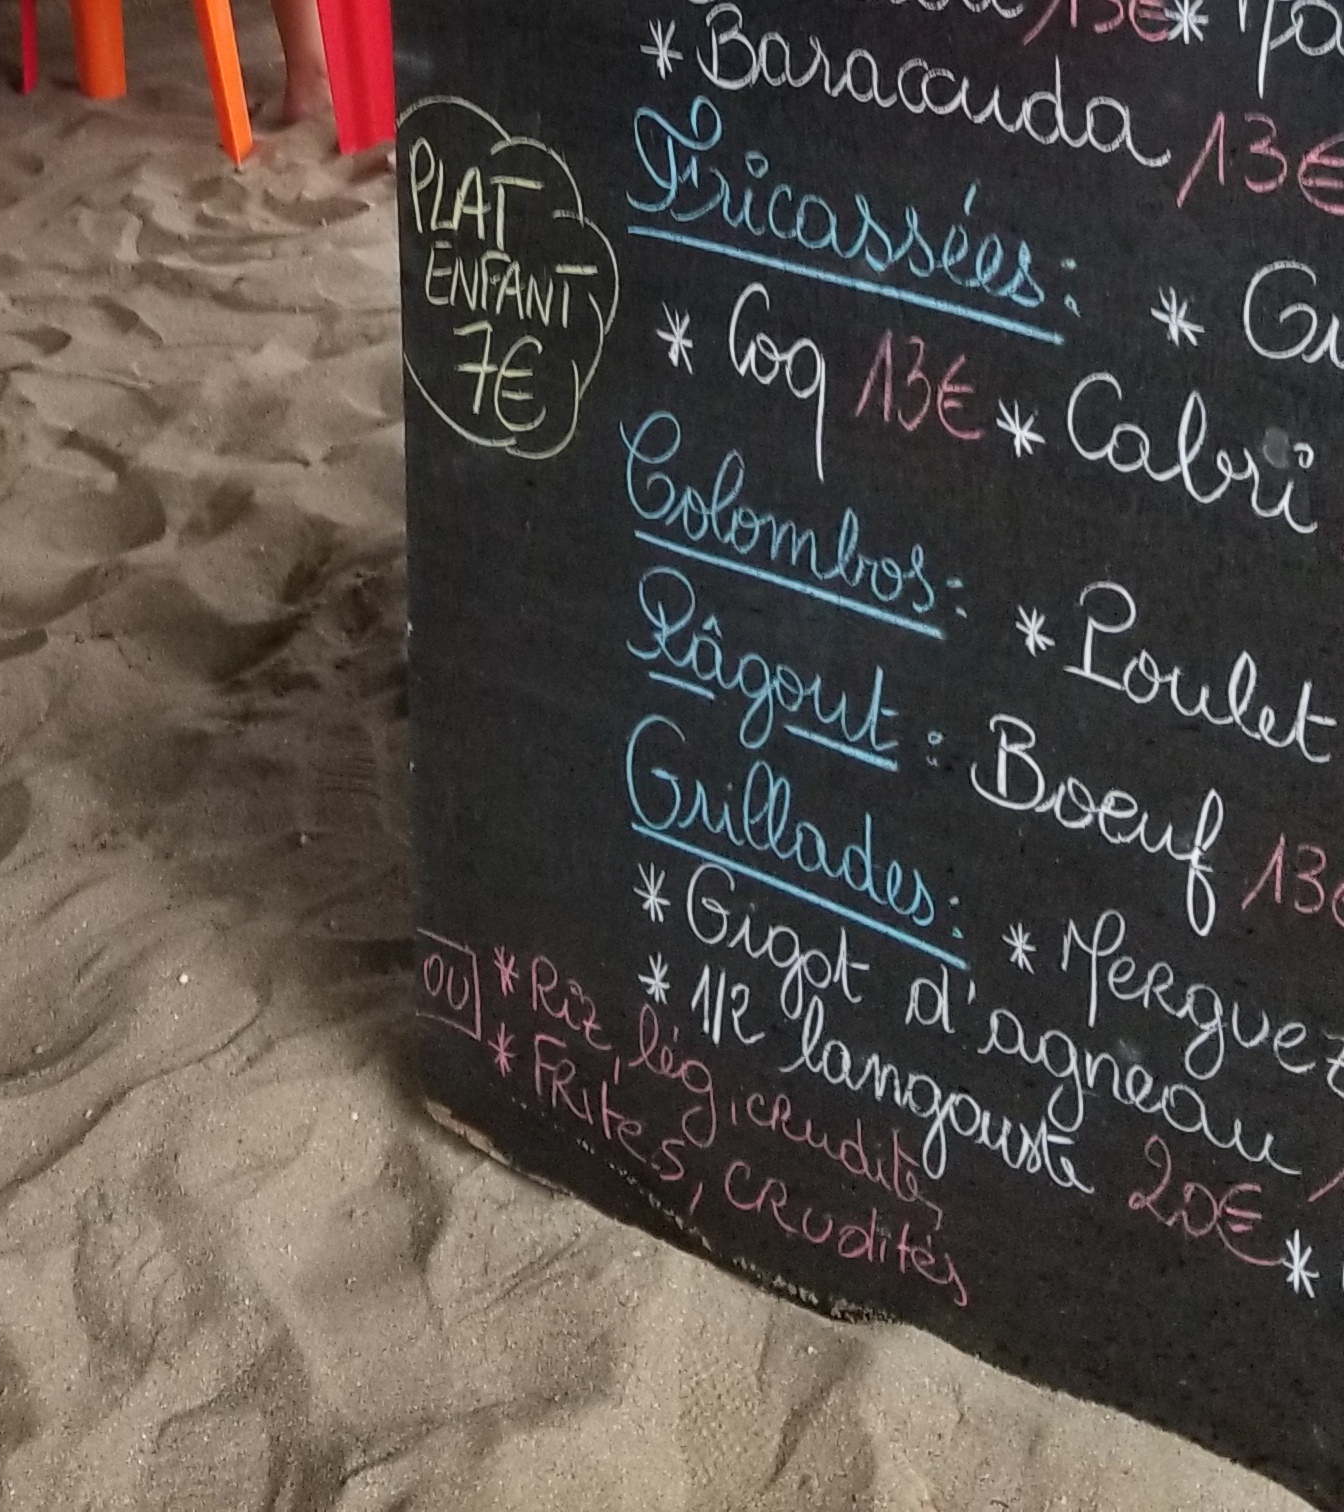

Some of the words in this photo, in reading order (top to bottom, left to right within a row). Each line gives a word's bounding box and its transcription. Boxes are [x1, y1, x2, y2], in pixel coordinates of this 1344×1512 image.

[409, 136, 546, 252] PLAT
[453, 321, 548, 434] 7€
[728, 282, 827, 482] Coq
[856, 327, 986, 441] 13€
[1068, 371, 1318, 536] Cabri
[1065, 580, 1338, 765] Poulet
[685, 860, 873, 1024] Gigot
[1128, 1133, 1283, 1266] 20€
